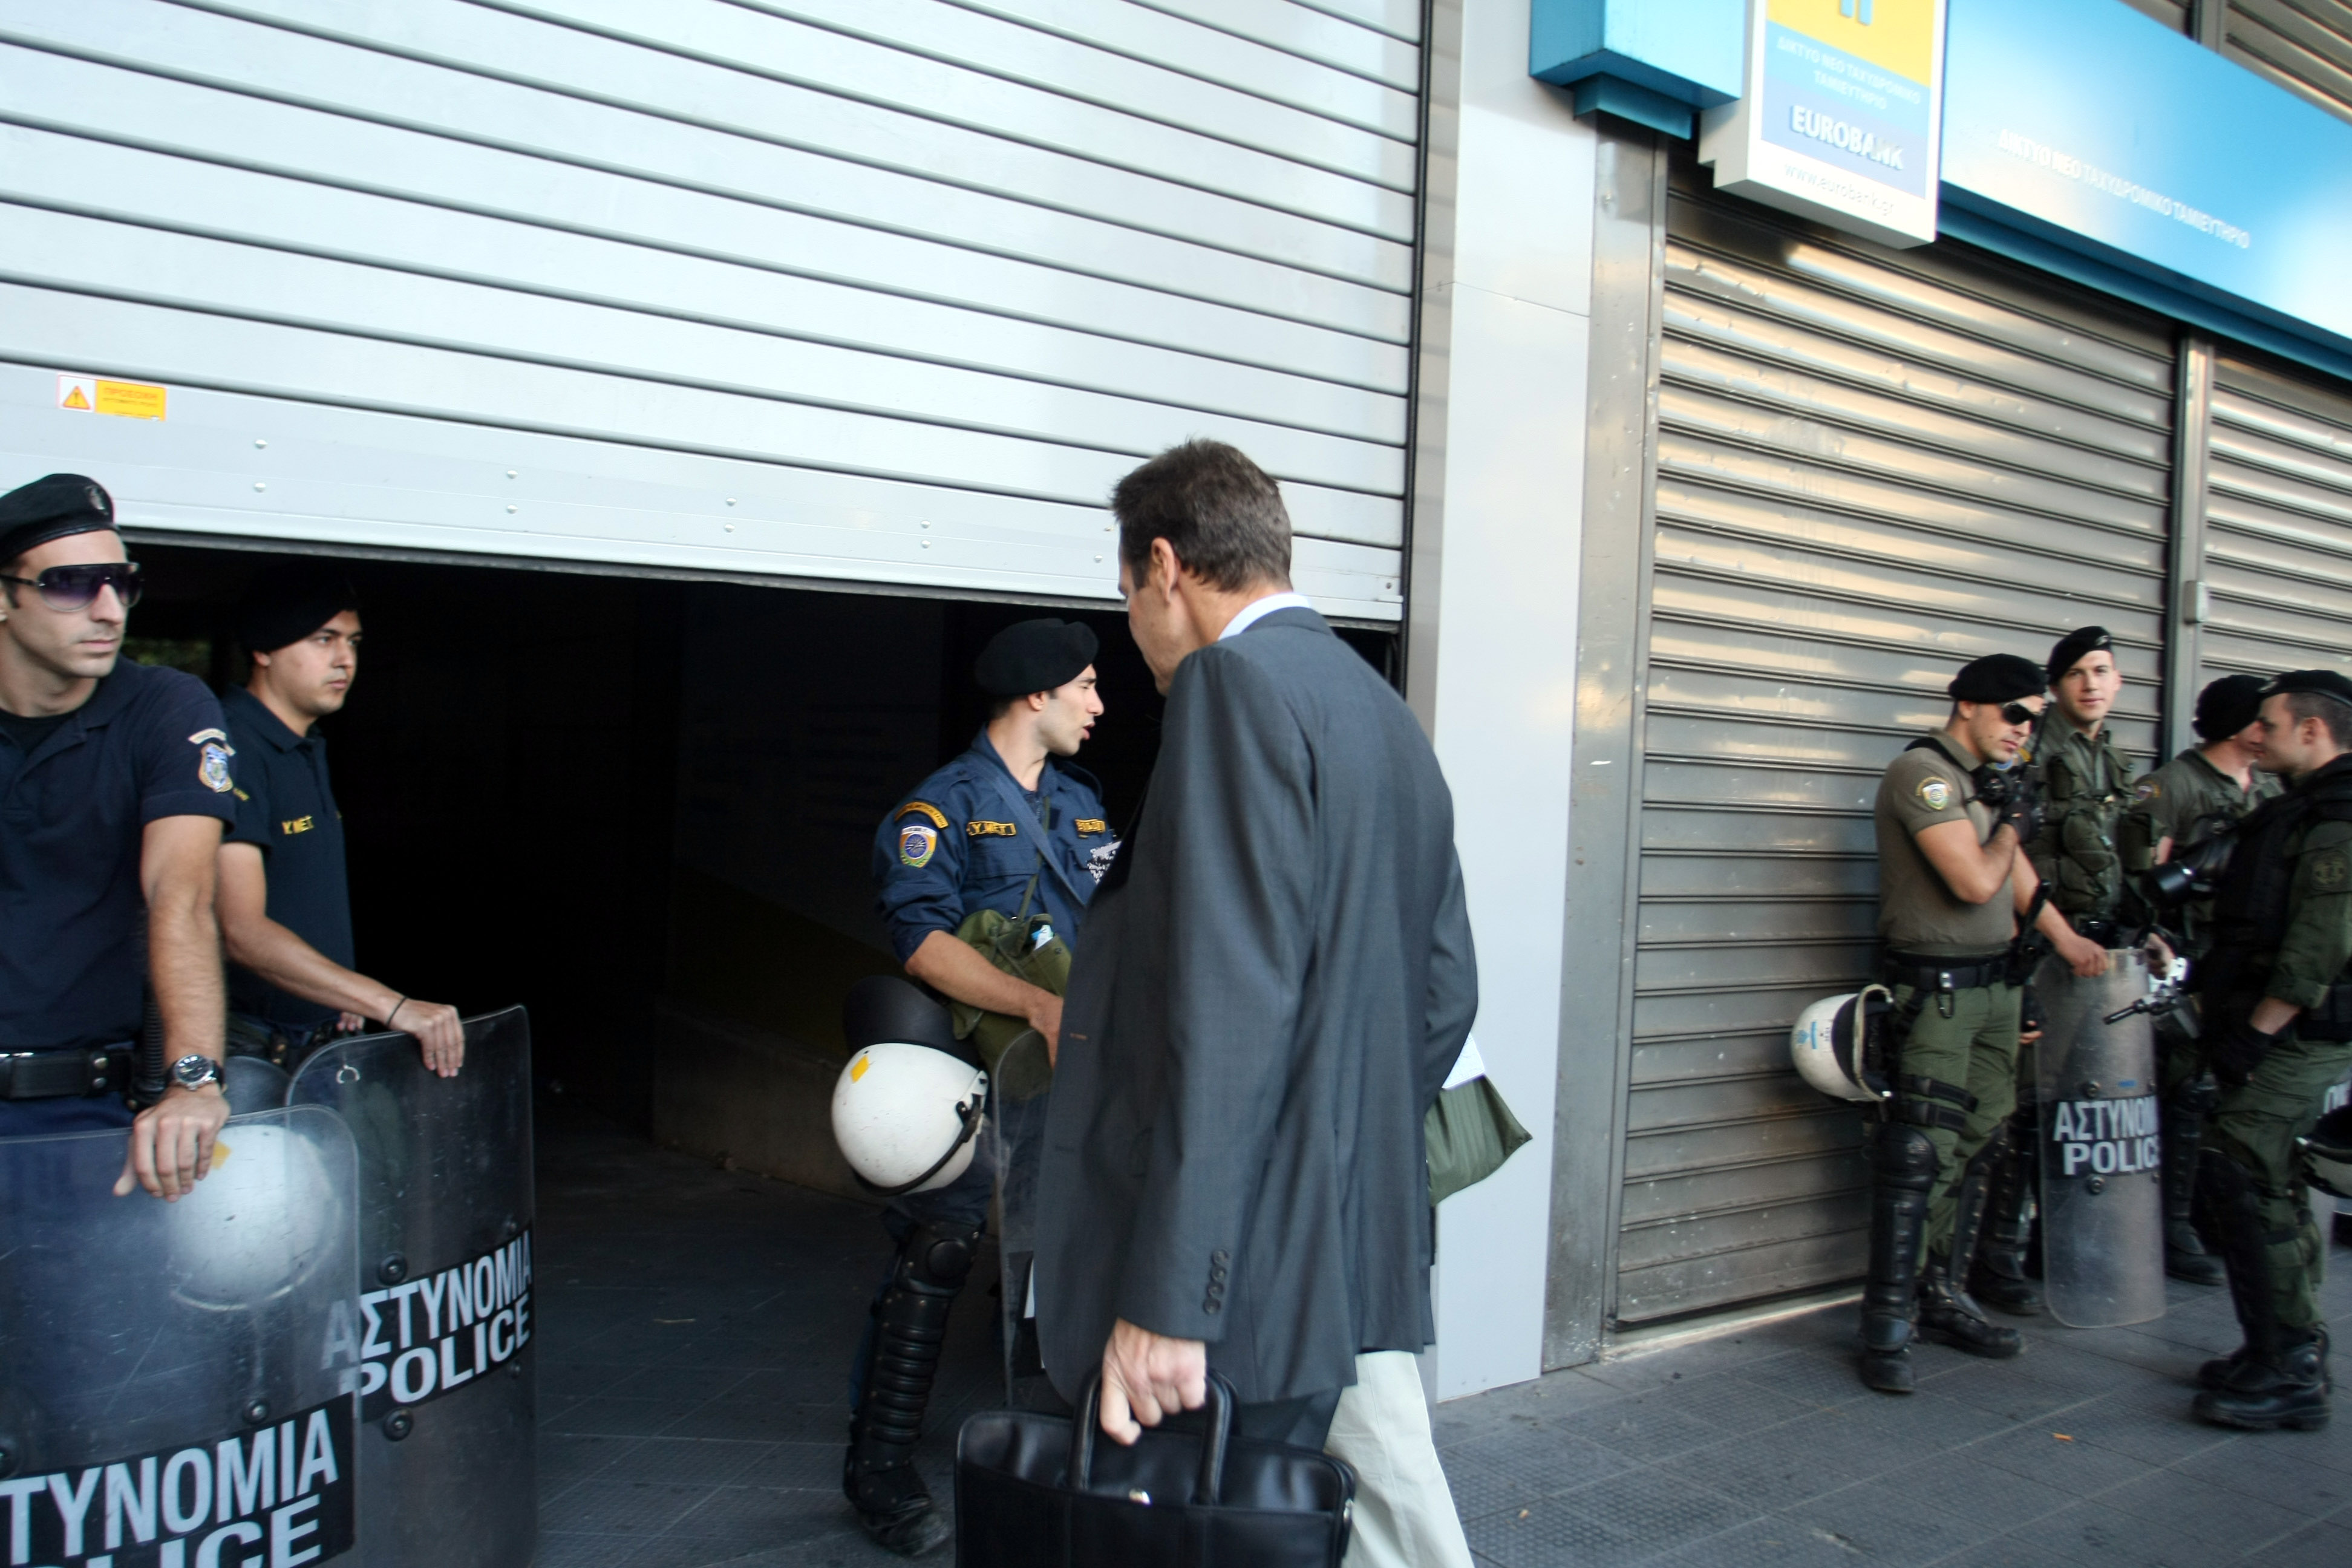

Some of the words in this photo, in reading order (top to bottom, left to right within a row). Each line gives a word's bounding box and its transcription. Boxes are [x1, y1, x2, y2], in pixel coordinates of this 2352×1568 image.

[1792, 105, 1904, 170] EUROBANK
[321, 1230, 532, 1370] ΑΣΤΥΝΟΜΙΑ
[339, 1293, 530, 1403] POLICE
[0, 1409, 339, 1566] ΤΥΝΟΜΙΑ
